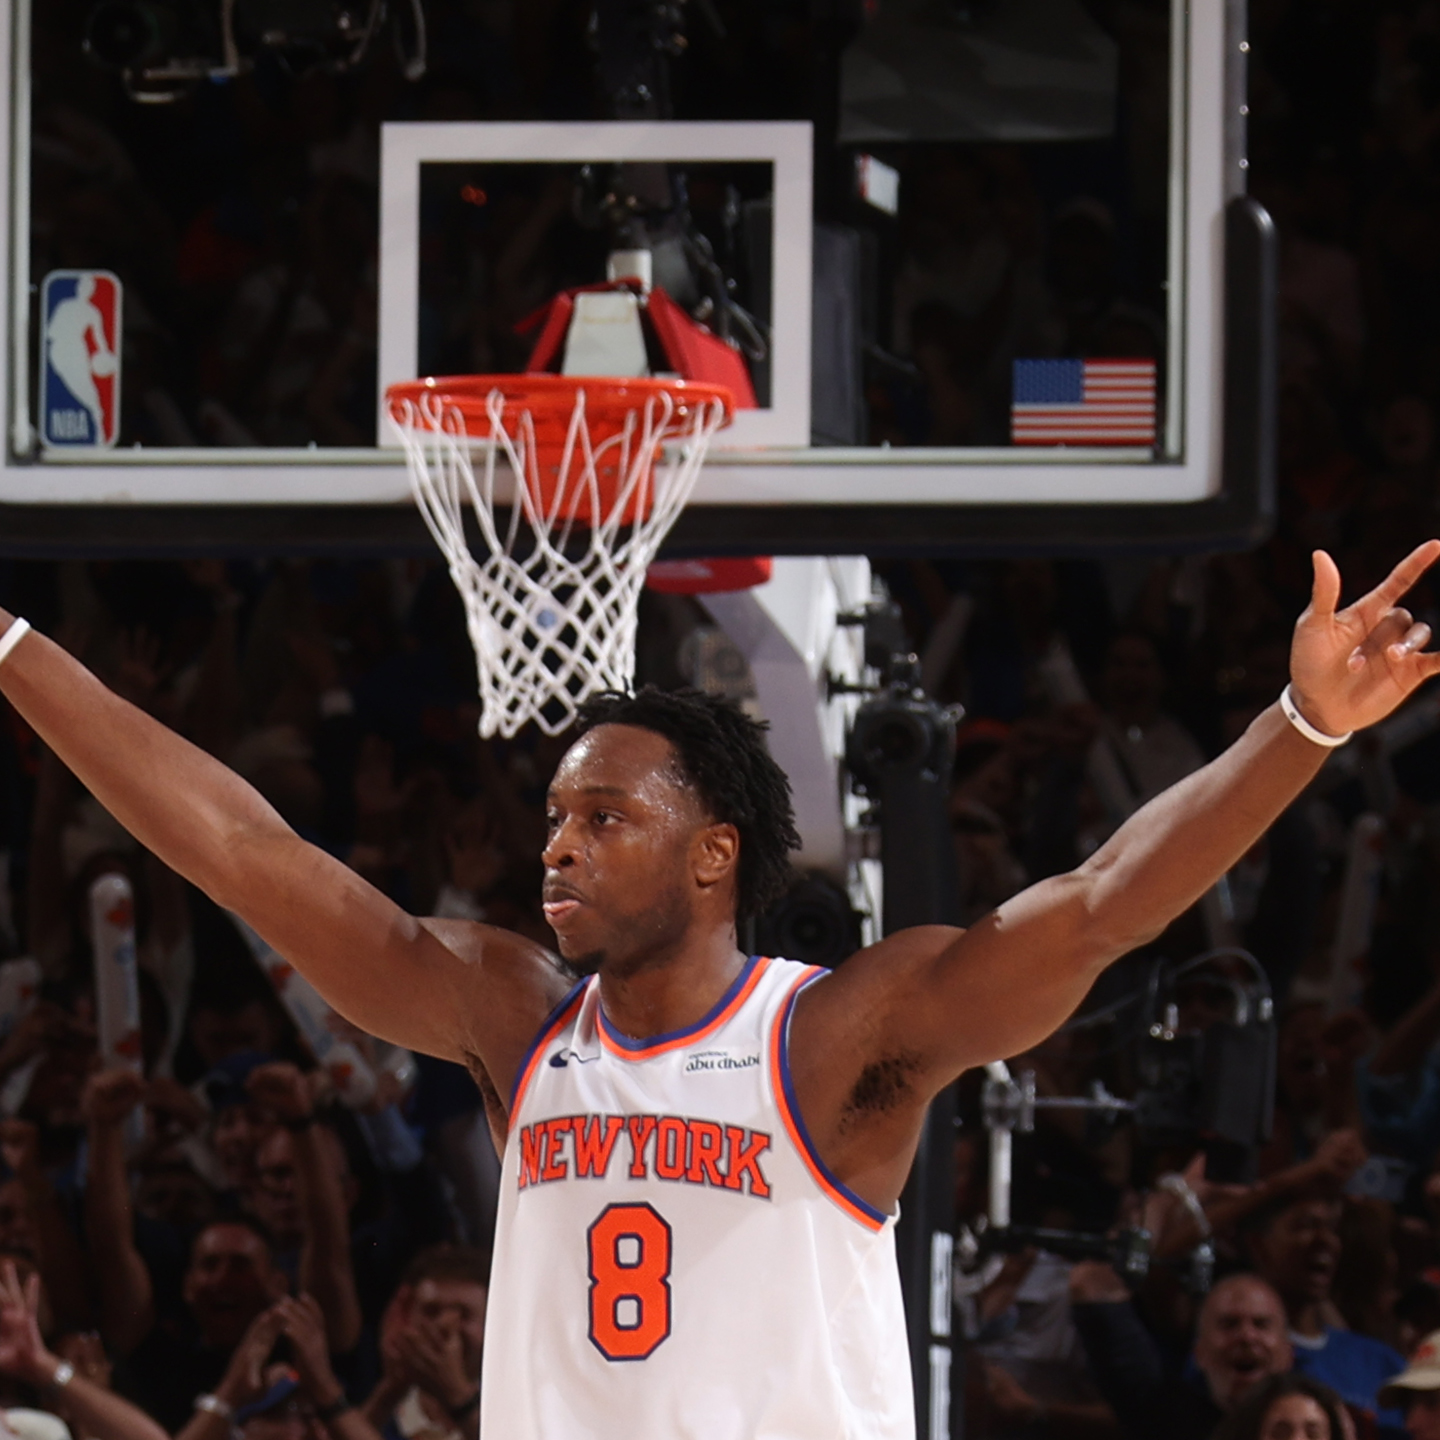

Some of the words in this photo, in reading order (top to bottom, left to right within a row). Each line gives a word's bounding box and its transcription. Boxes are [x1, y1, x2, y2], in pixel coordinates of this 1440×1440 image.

[50, 407, 90, 440] NBA
[686, 1058, 714, 1071] abu
[717, 1052, 760, 1069] dhabi
[517, 1113, 624, 1192] NEW
[624, 1114, 773, 1202] YORK
[586, 1201, 672, 1362] 8
